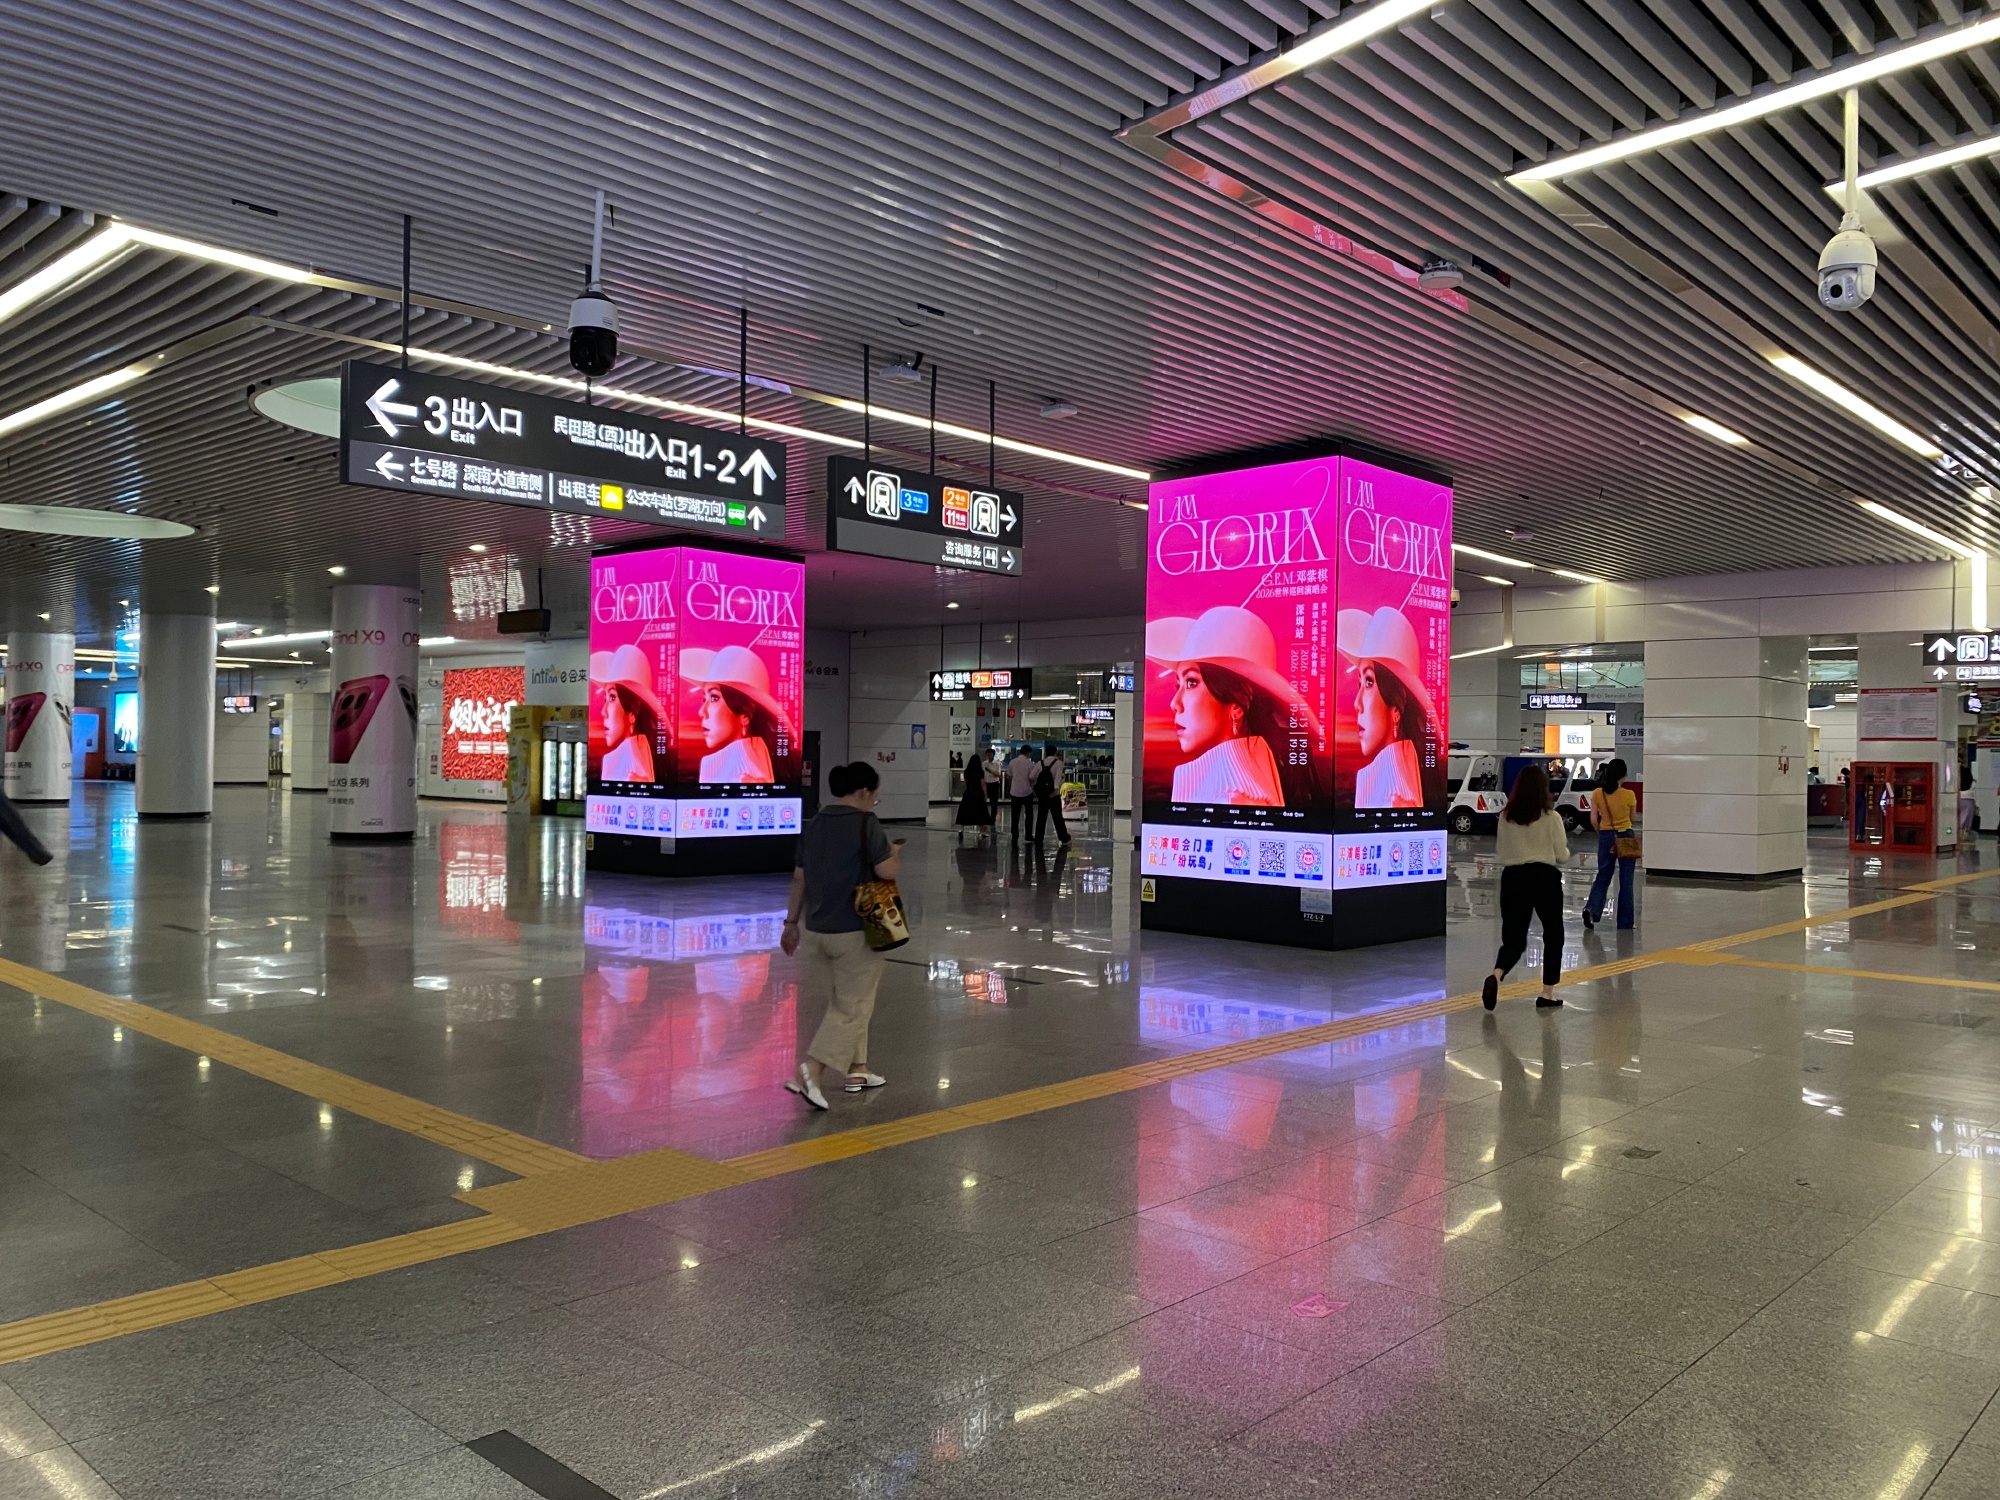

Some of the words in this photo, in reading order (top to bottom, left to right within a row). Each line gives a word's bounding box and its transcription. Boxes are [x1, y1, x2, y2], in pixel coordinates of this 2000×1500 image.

[450, 430, 476, 445] Exit
[596, 439, 613, 450] Road
[410, 456, 458, 481] 七号路
[463, 464, 543, 493] 深南大道南侧
[665, 466, 686, 480] Exit
[410, 476, 438, 486] Seventh
[438, 479, 456, 489] Road
[558, 478, 600, 502] 出租车
[1346, 476, 1352, 504] I
[463, 482, 481, 492] South
[482, 485, 495, 494] Side
[527, 492, 542, 500] Blvd
[659, 508, 672, 517] Bus
[1158, 498, 1164, 524] I
[1168, 494, 1199, 522] AM
[945, 541, 981, 558] 咨询服务
[966, 558, 982, 566] Service
[1294, 604, 1305, 639] 深圳站
[362, 630, 385, 646] X9
[26, 662, 43, 672] X9
[1542, 695, 1582, 704] 咨询服务台
[349, 778, 369, 788] 系列
[1149, 836, 1214, 853] 买演唱会门票
